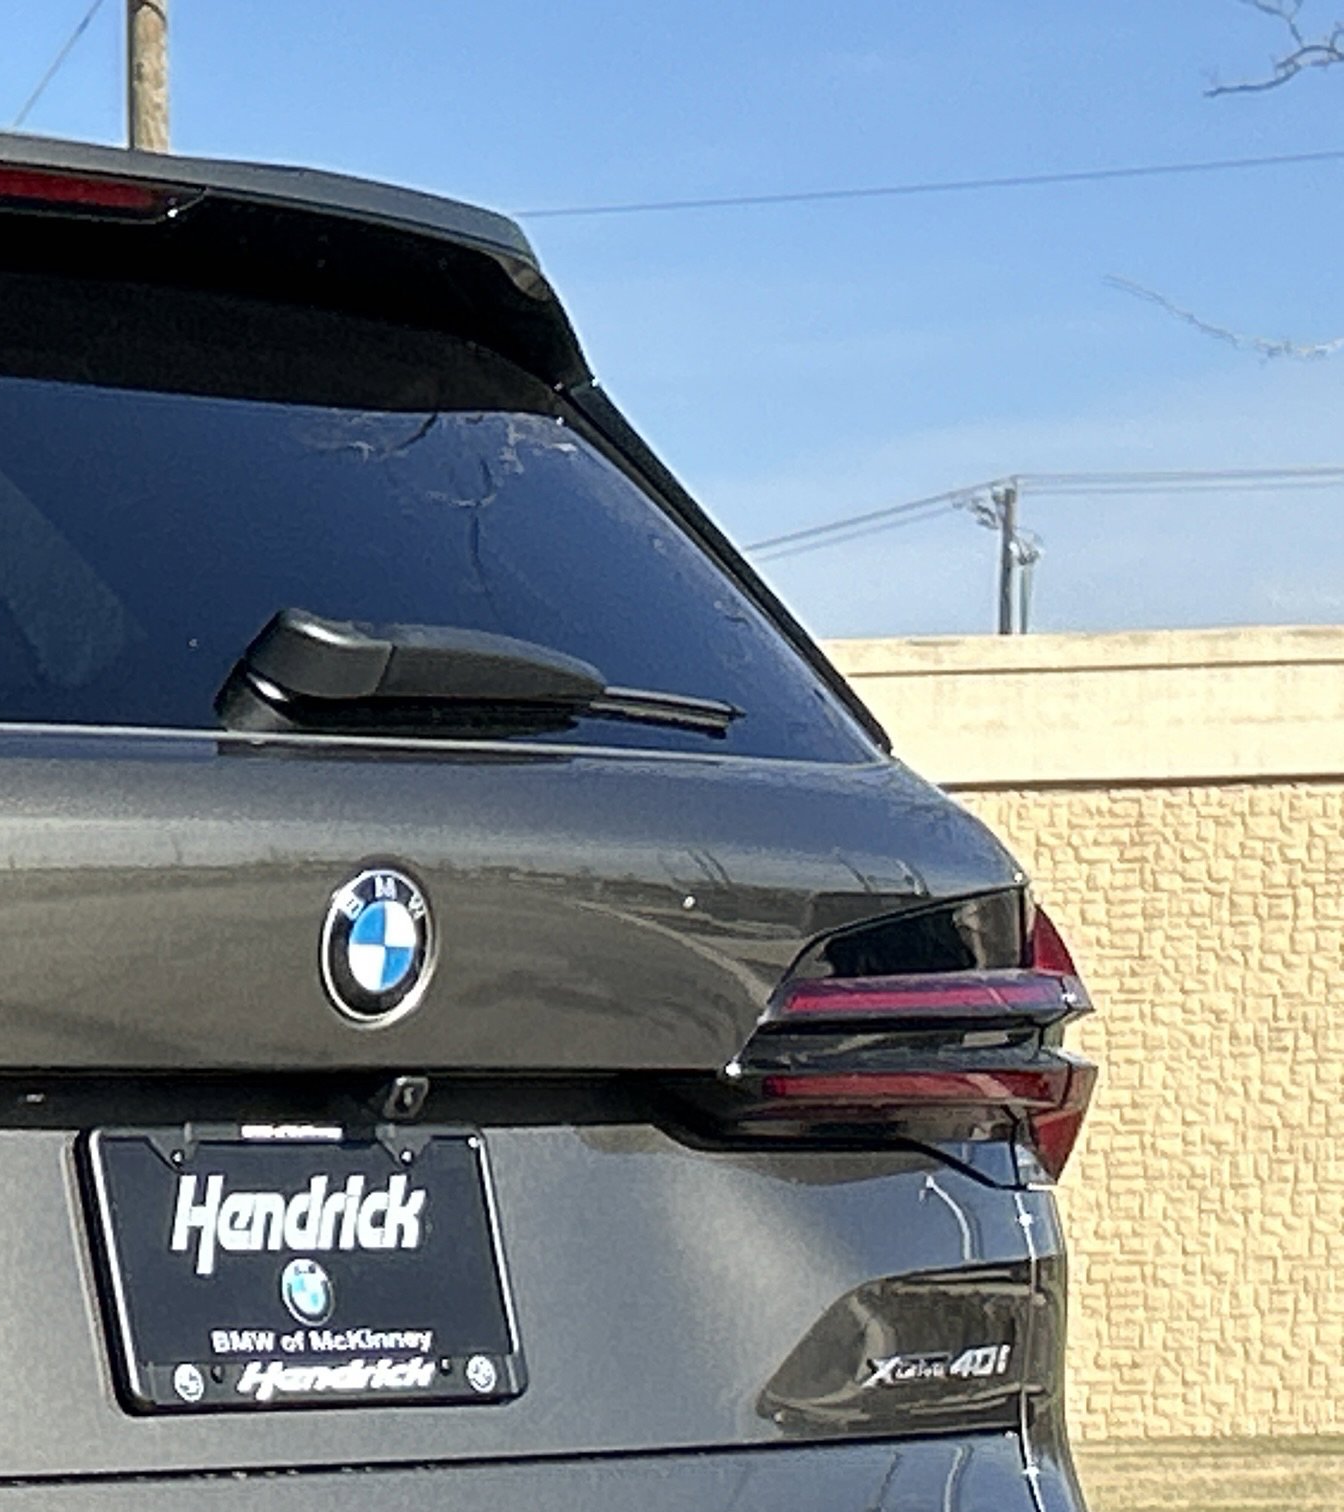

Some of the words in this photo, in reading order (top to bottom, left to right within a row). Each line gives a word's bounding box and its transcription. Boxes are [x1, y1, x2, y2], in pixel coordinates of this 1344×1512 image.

[337, 875, 427, 921] BMW
[170, 1173, 427, 1276] Hendrick
[211, 1329, 275, 1353] BMW
[280, 1330, 306, 1352] of
[308, 1328, 434, 1352] McKinney
[236, 1357, 436, 1401] Hendrick
